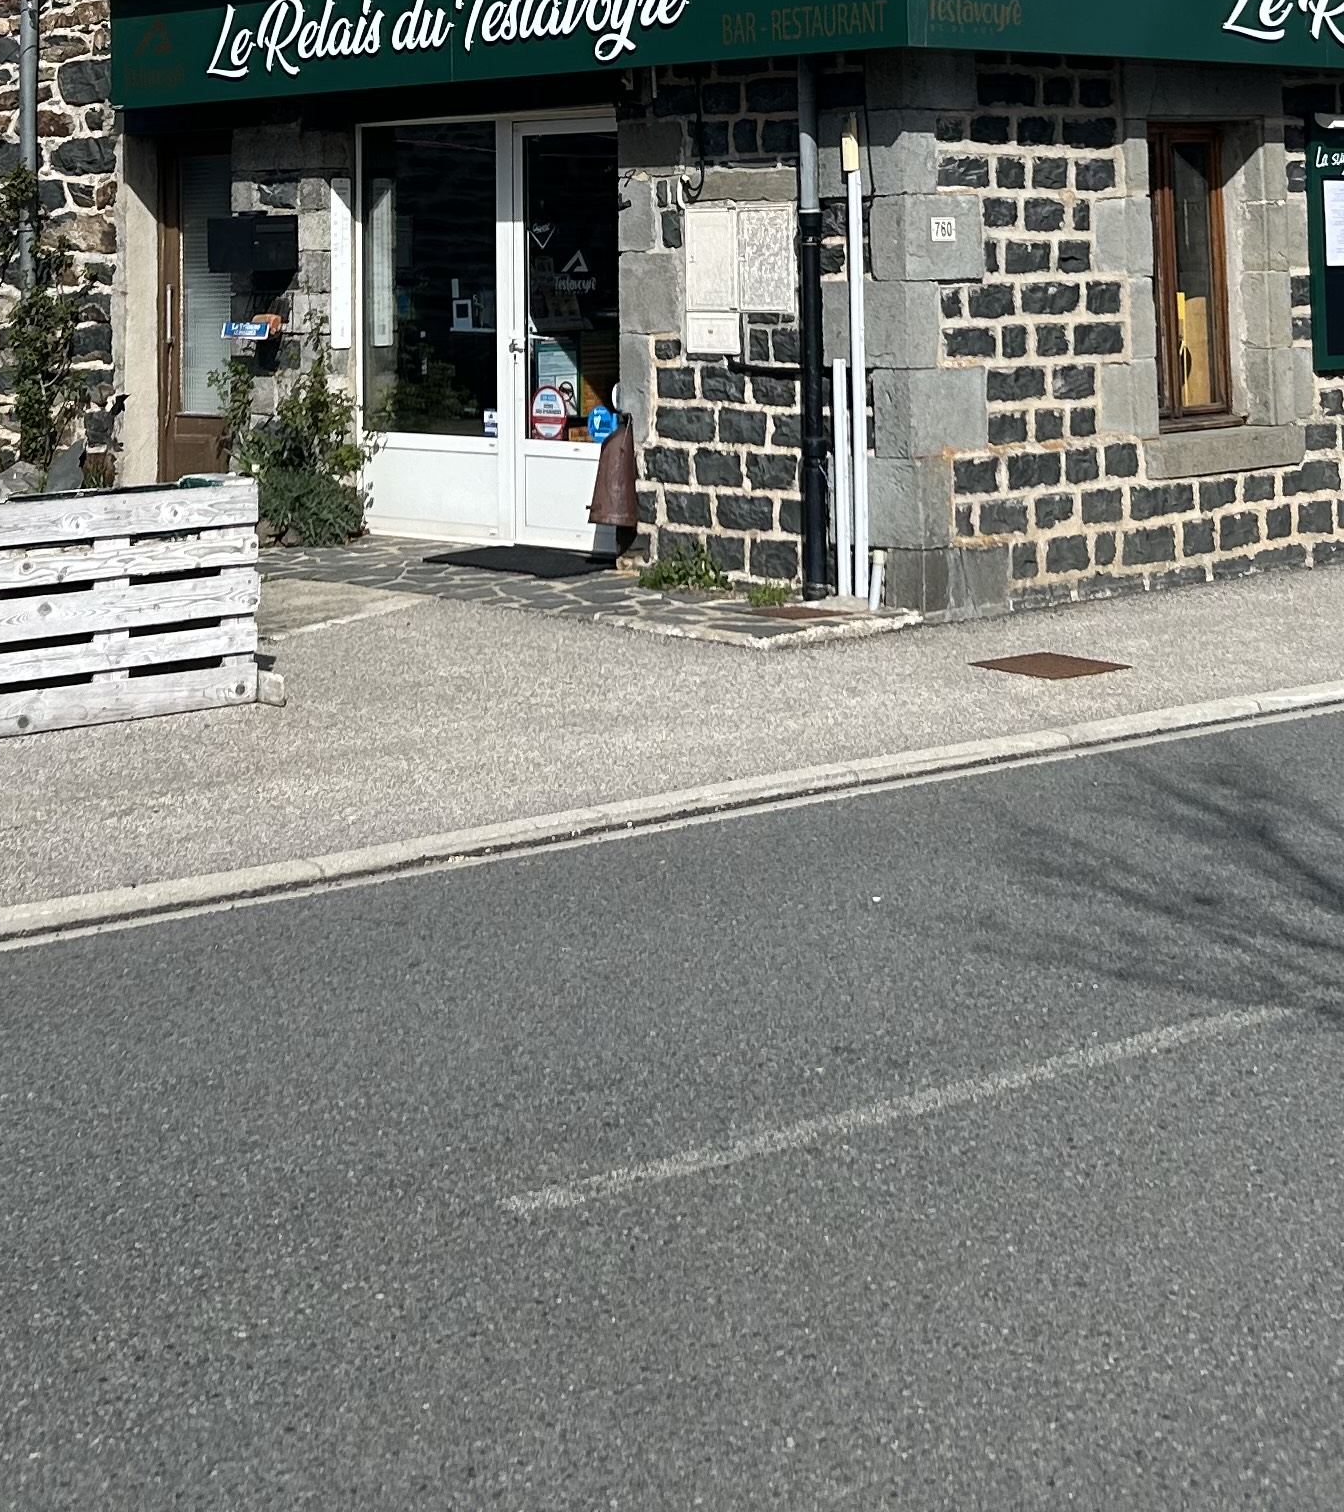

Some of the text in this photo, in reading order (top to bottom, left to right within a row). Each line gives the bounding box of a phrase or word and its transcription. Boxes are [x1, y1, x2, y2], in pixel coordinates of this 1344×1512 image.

[721, 11, 756, 46] BAR
[771, 0, 888, 41] RESTAURANT
[206, 4, 255, 78] Le
[1315, 145, 1329, 168] La
[934, 221, 953, 237] 760
